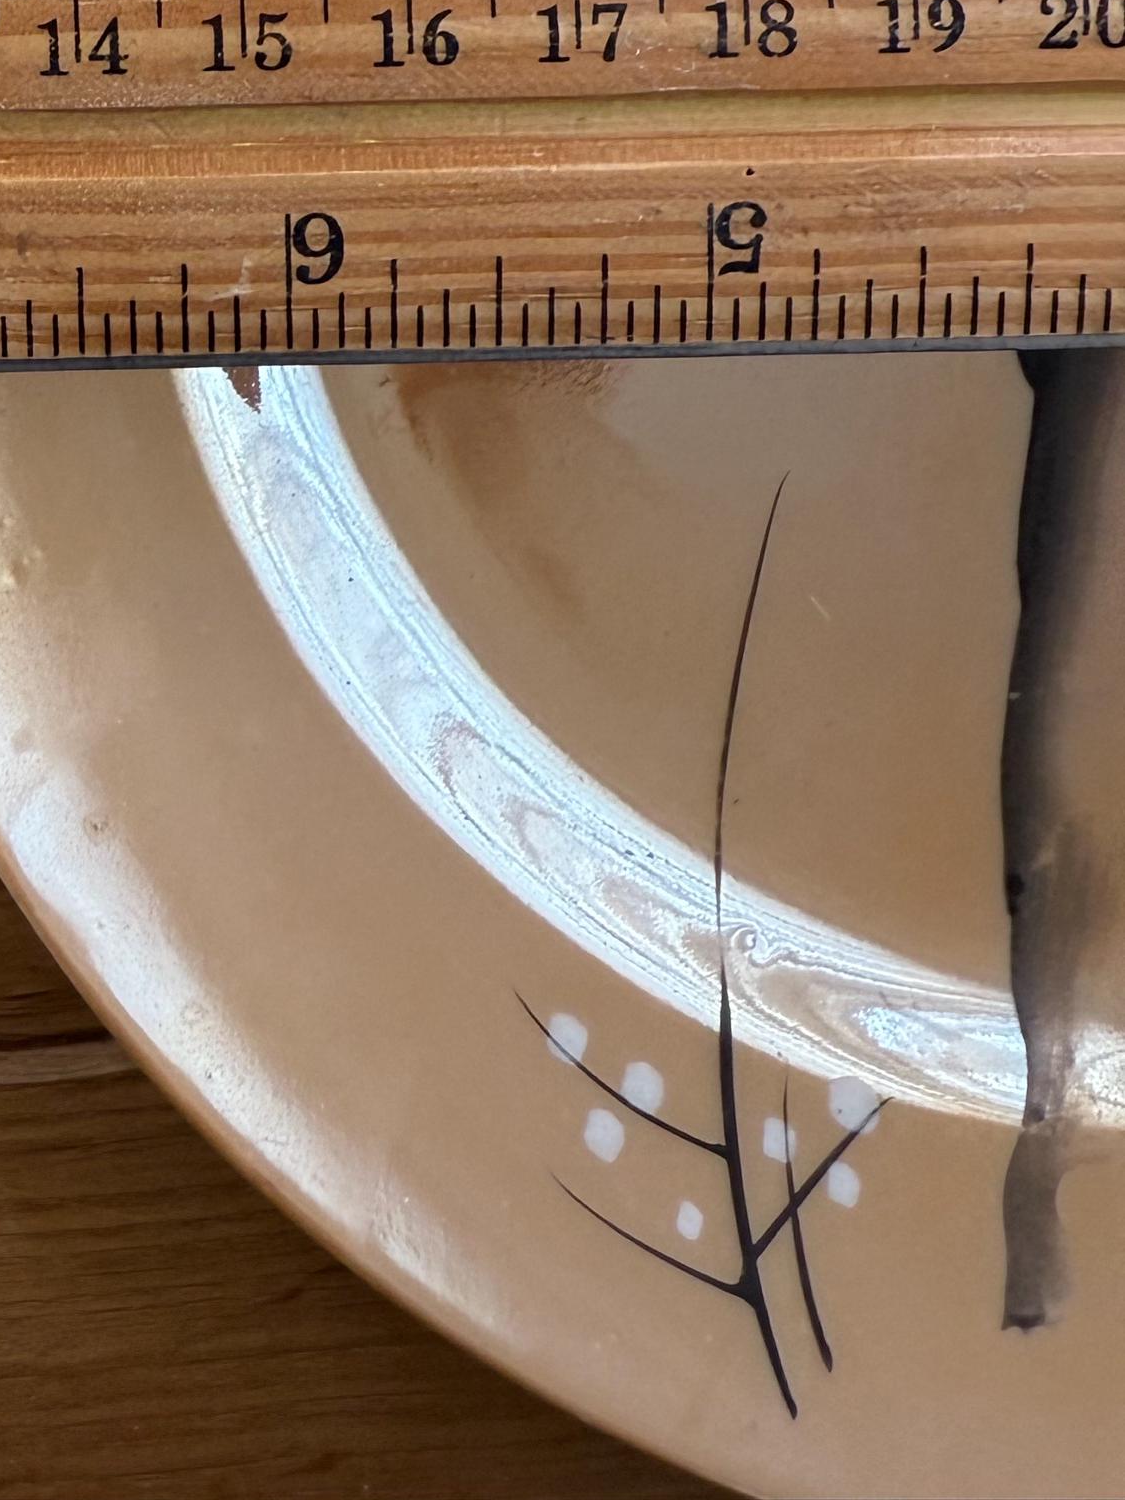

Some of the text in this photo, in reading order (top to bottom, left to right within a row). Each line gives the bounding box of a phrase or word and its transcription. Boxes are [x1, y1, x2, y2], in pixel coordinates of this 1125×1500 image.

[37, 17, 130, 77] 14
[201, 12, 294, 73] 15
[371, 8, 460, 68] 16
[535, 3, 630, 63] 17
[714, 200, 768, 276] 5
